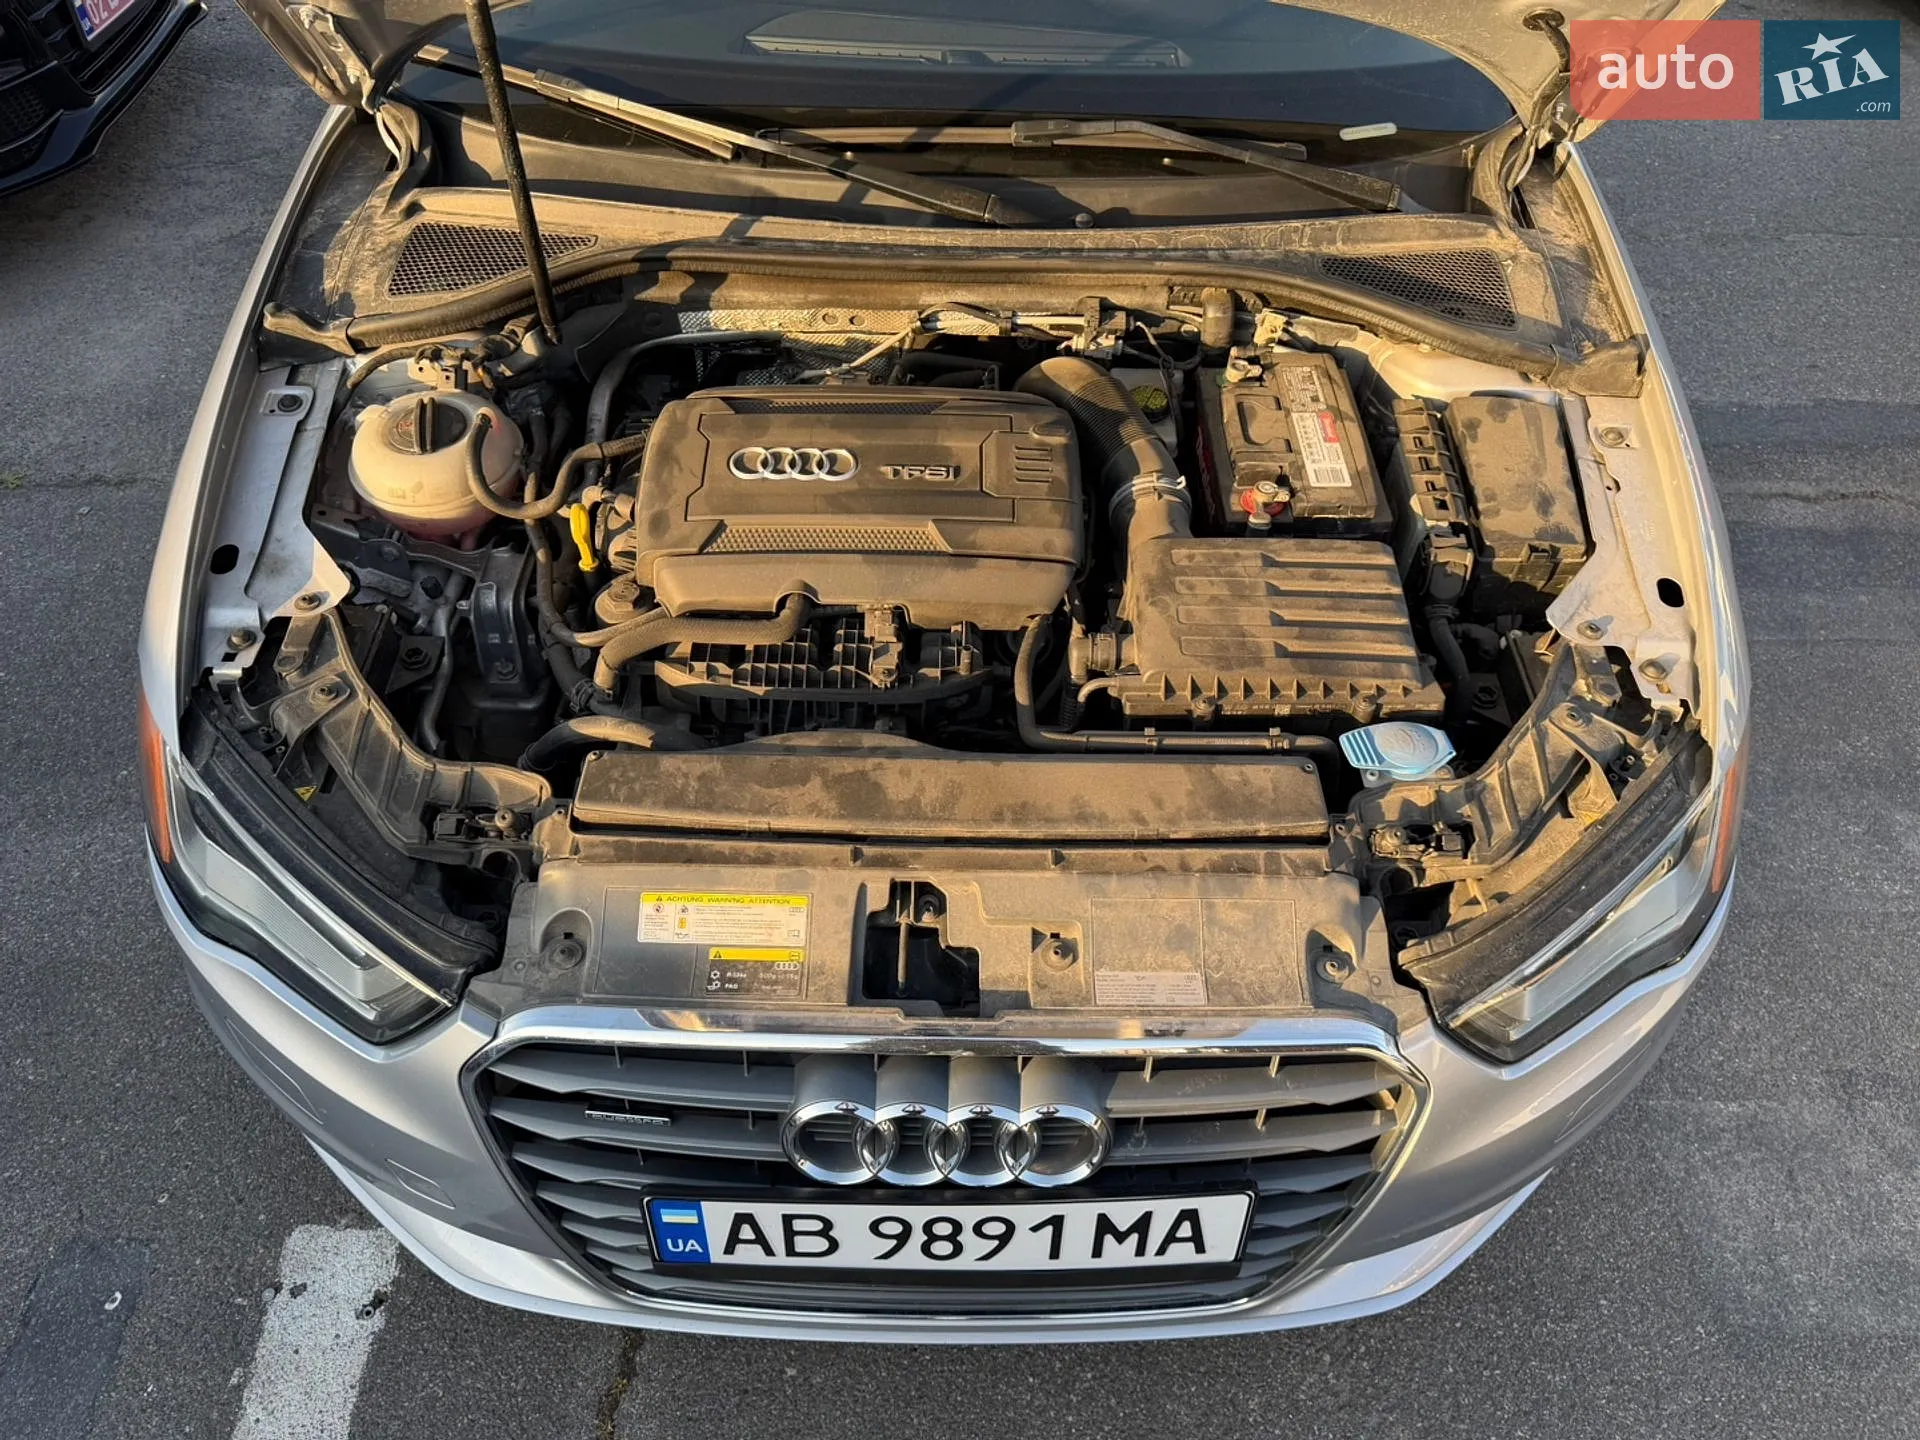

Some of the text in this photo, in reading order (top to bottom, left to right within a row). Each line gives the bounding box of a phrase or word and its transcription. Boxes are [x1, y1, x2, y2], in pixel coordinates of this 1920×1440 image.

[880, 465, 956, 481] TFSI
[722, 1207, 1207, 1262] AB 9891 MA
[666, 1238, 704, 1252] UA
